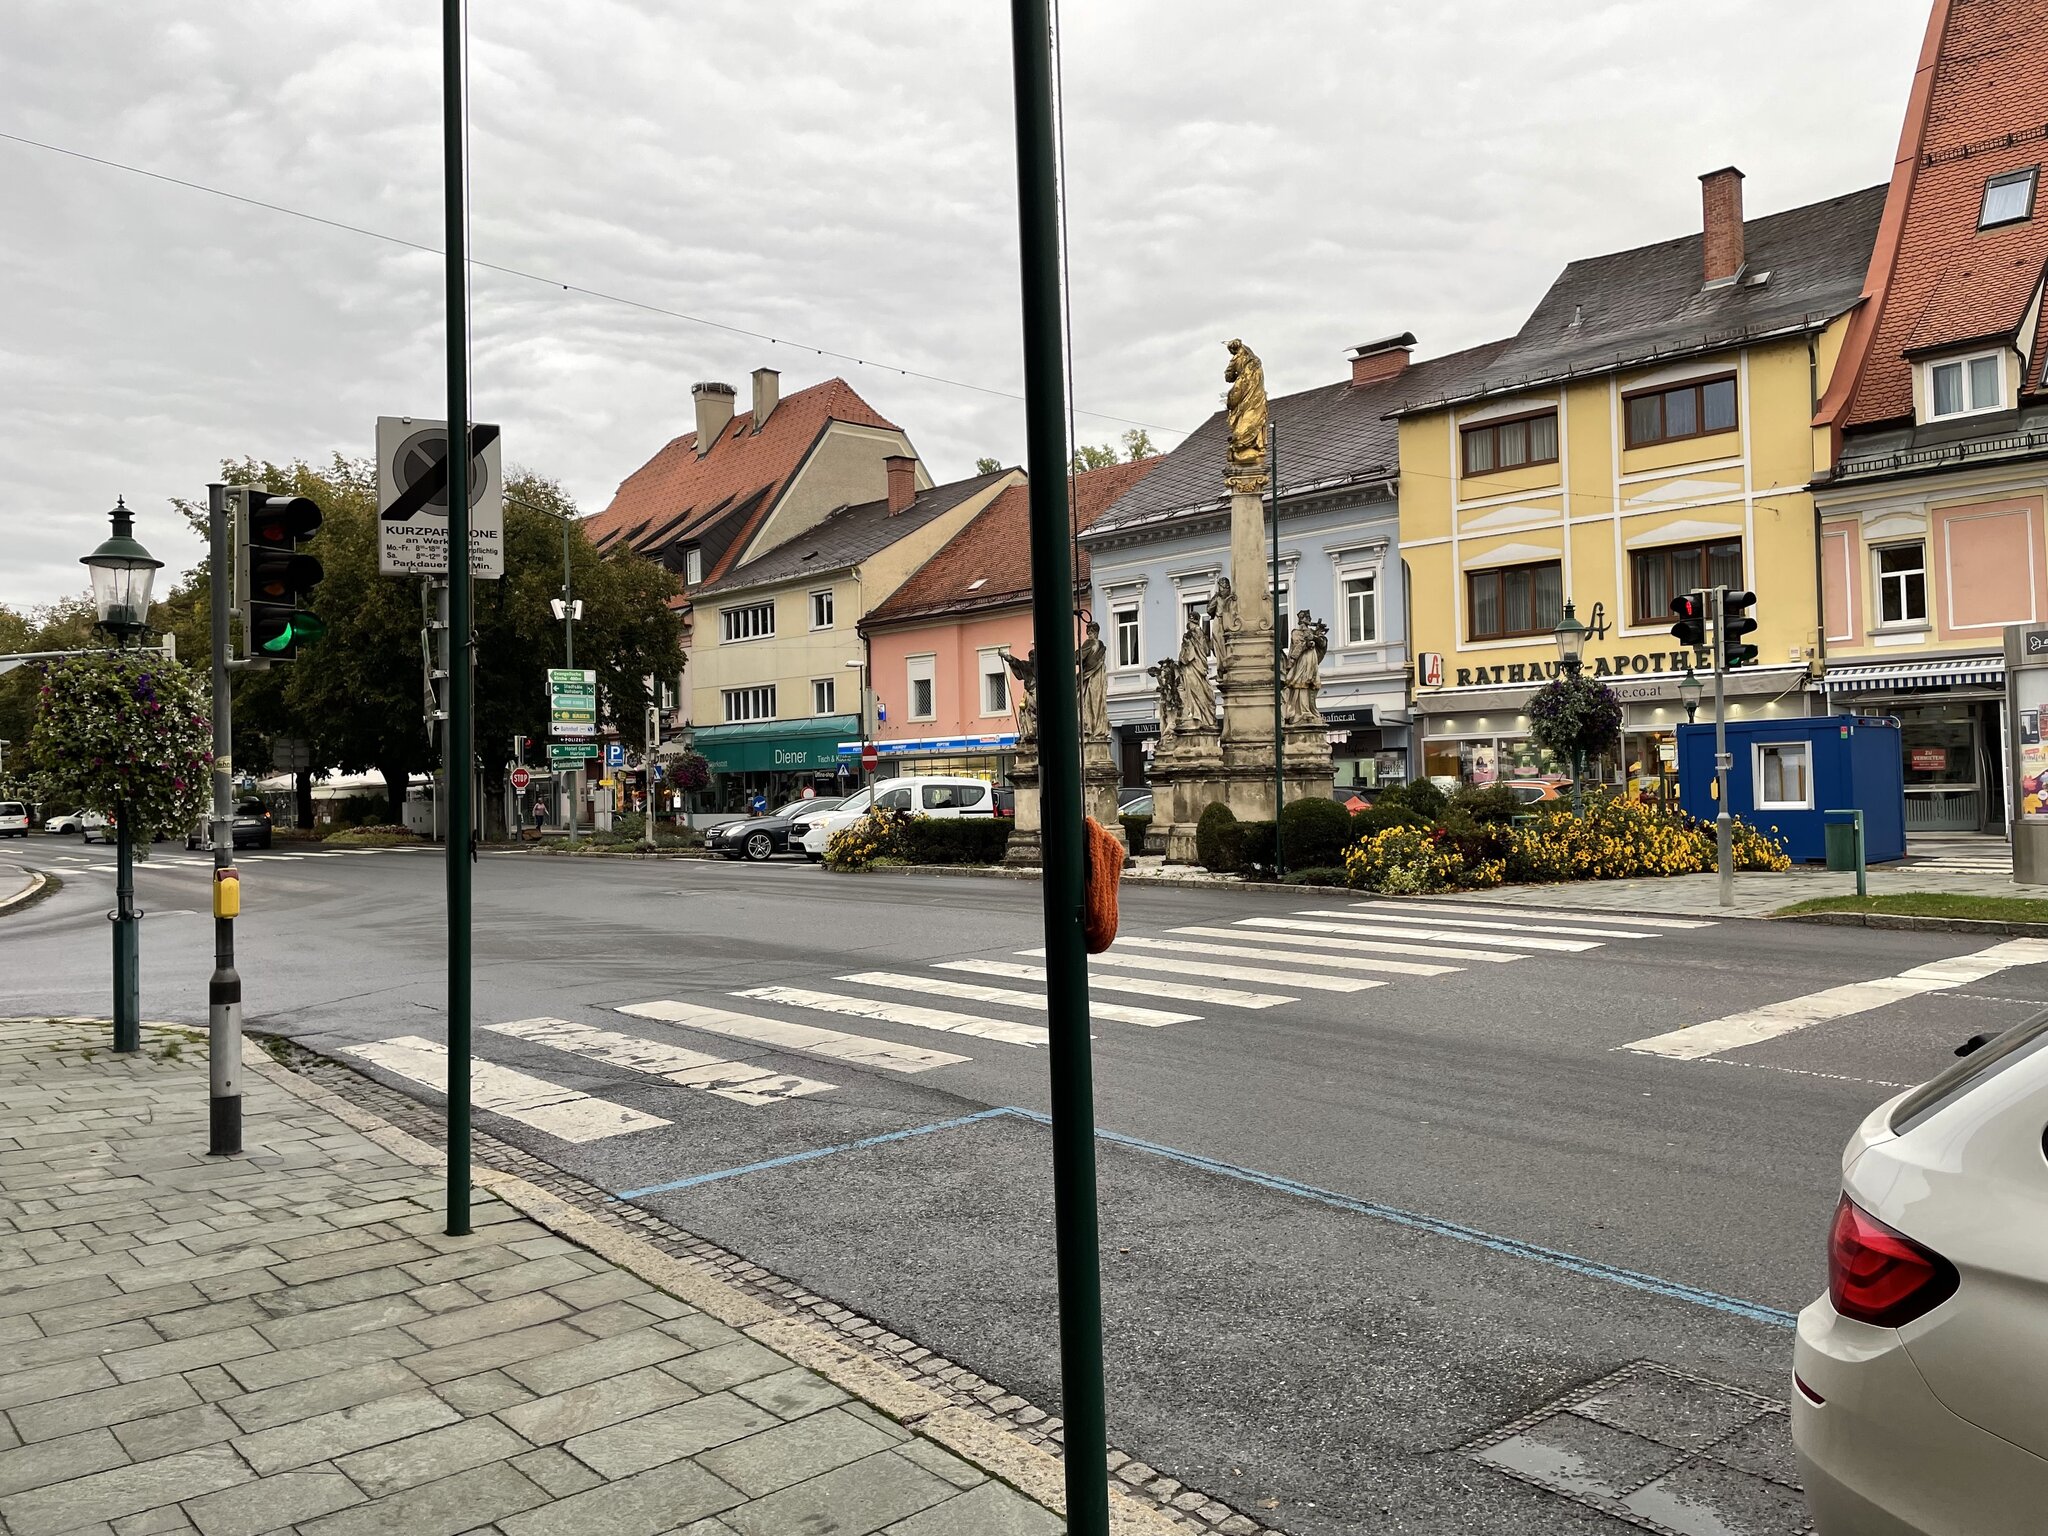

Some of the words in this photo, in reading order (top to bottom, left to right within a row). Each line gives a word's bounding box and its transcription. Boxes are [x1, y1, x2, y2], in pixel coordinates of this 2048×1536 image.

[385, 525, 498, 539] KURZPARONE
[393, 560, 447, 568] Parkdauer
[611, 746, 620, 760] P
[775, 749, 807, 764] Diener
[817, 755, 831, 763] Tisch
[831, 755, 836, 763] &
[513, 773, 528, 783] STOP
